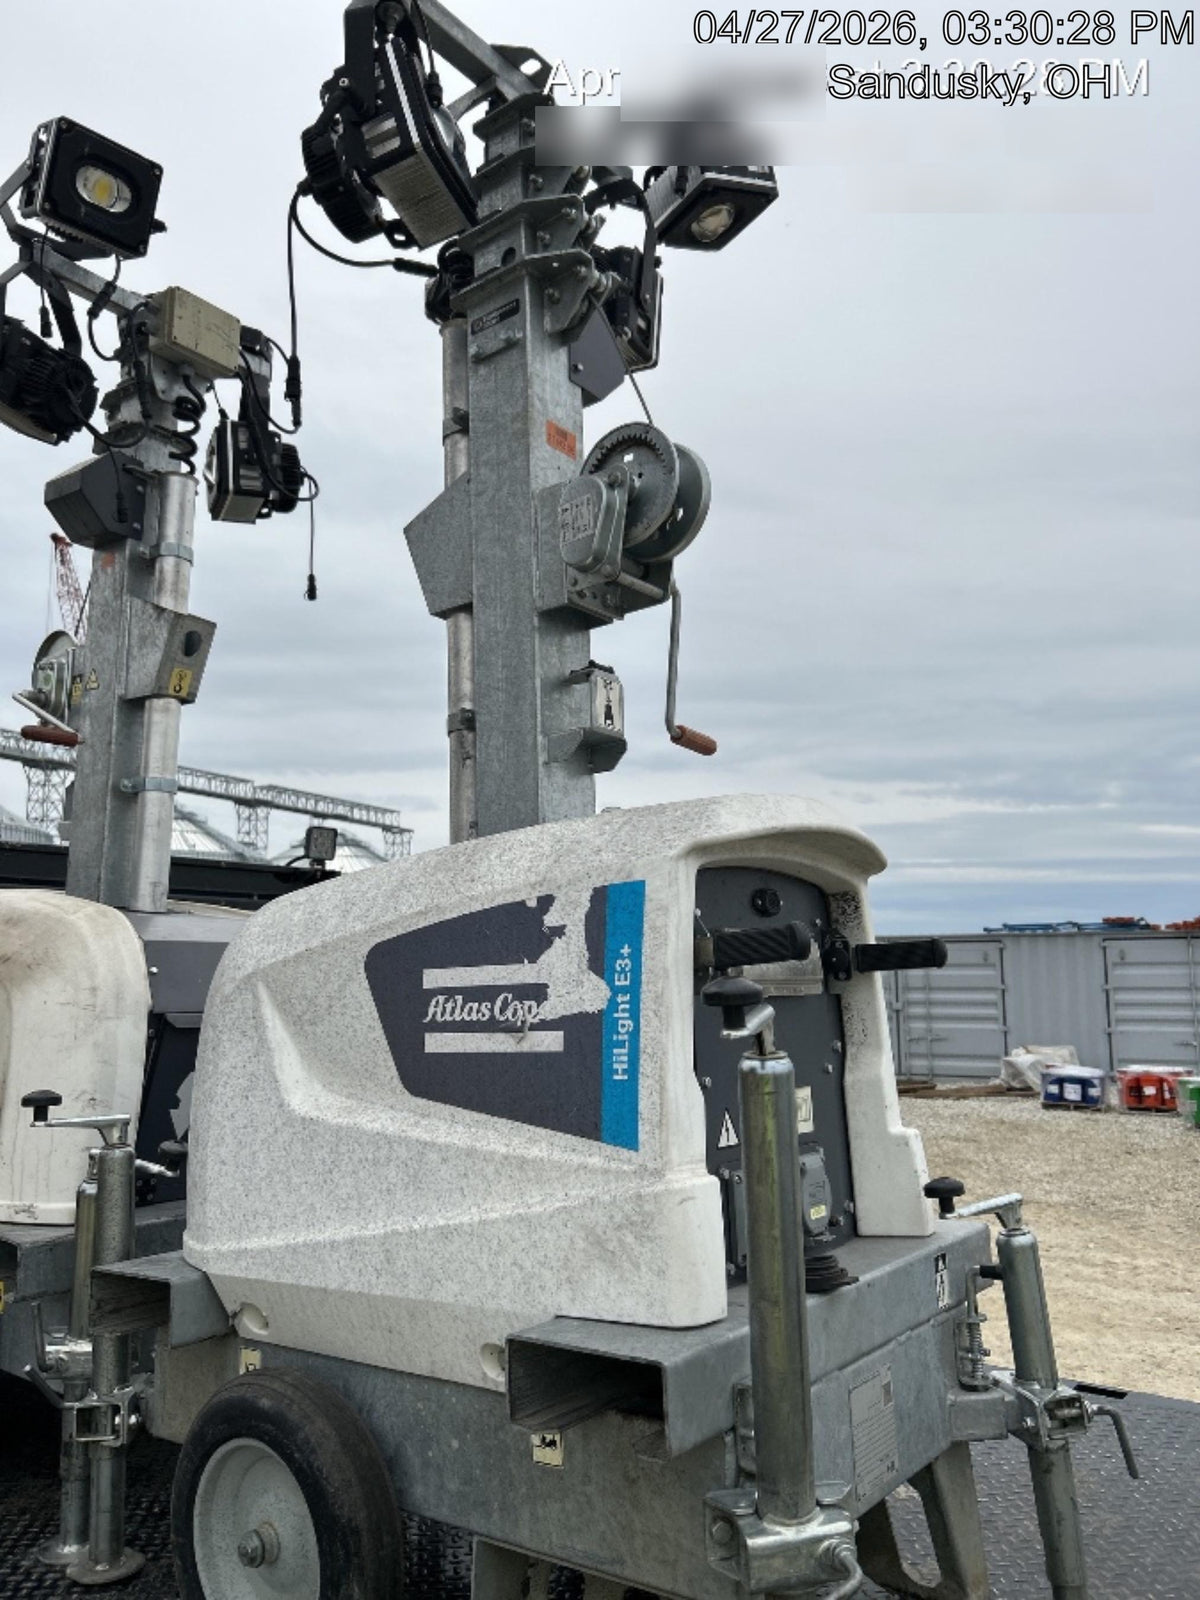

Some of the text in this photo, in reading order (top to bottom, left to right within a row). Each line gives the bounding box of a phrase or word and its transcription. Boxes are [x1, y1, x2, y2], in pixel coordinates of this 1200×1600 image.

[423, 995, 491, 1023] Atlas
[613, 943, 634, 1080] HiLight E3+
